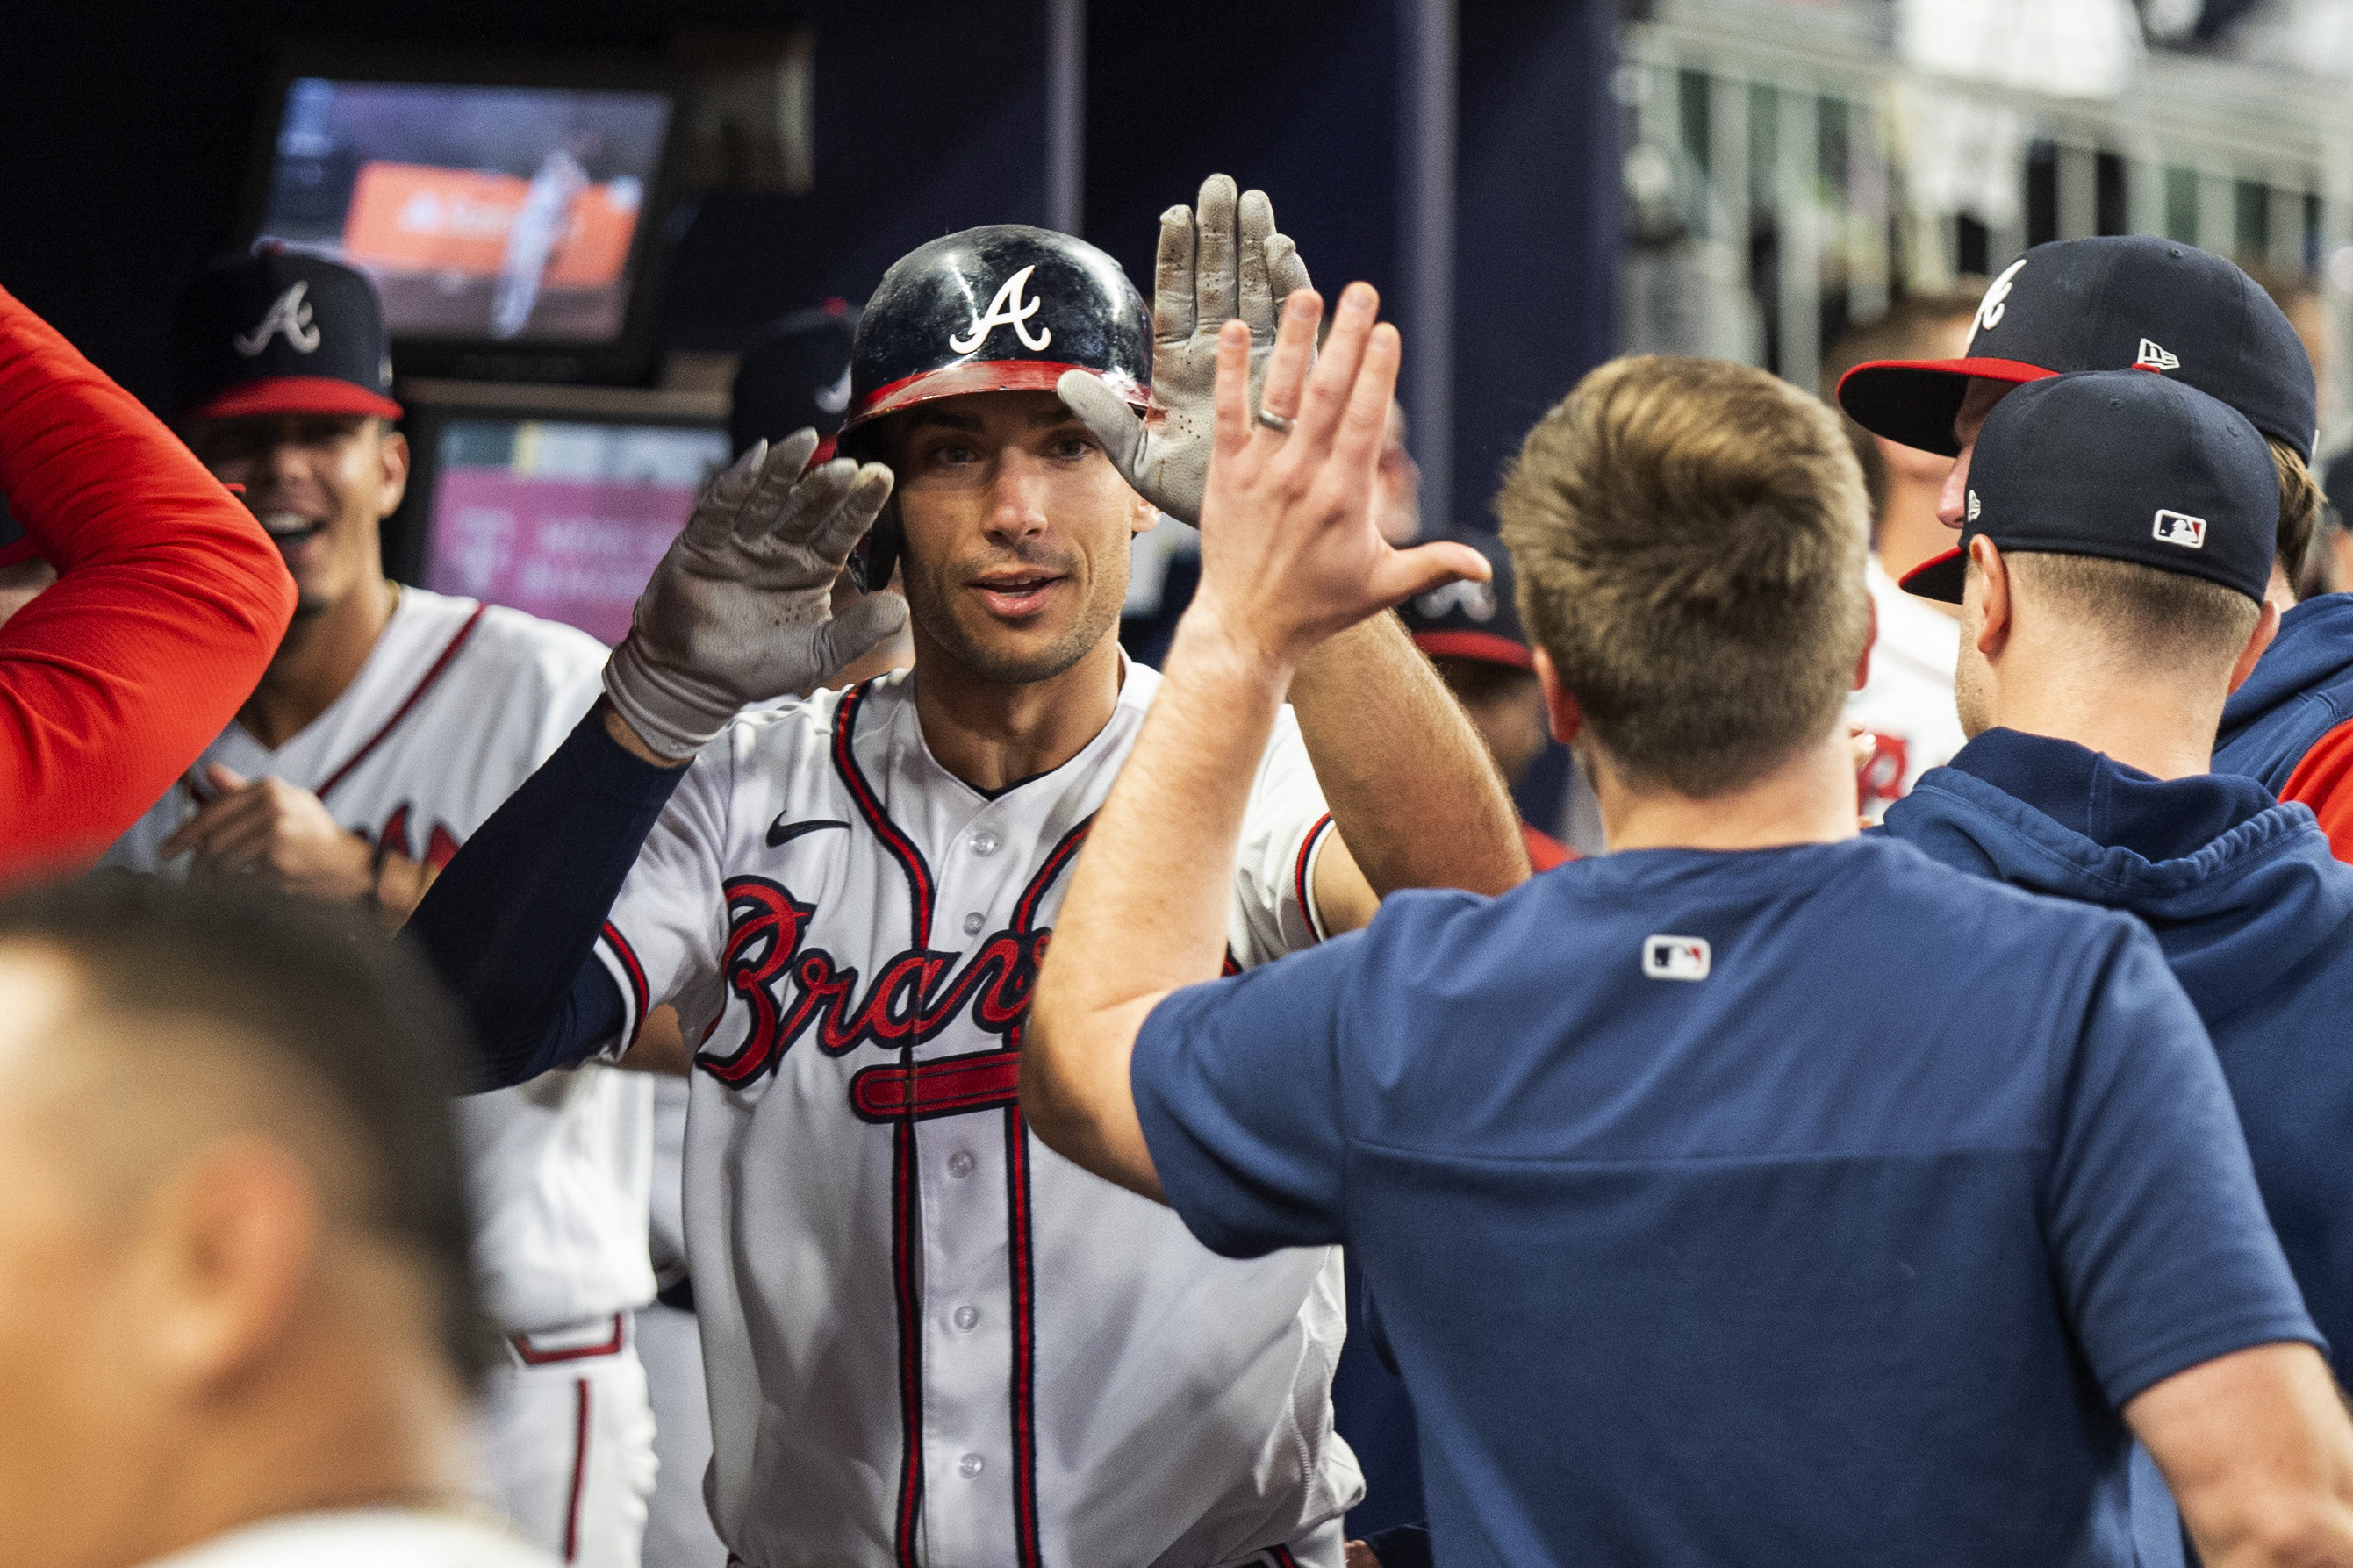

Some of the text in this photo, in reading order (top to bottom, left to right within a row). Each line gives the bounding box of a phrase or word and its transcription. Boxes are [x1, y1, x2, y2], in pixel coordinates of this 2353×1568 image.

[233, 280, 320, 357] A
[950, 265, 1051, 354] A
[695, 875, 1051, 1091] Brav
